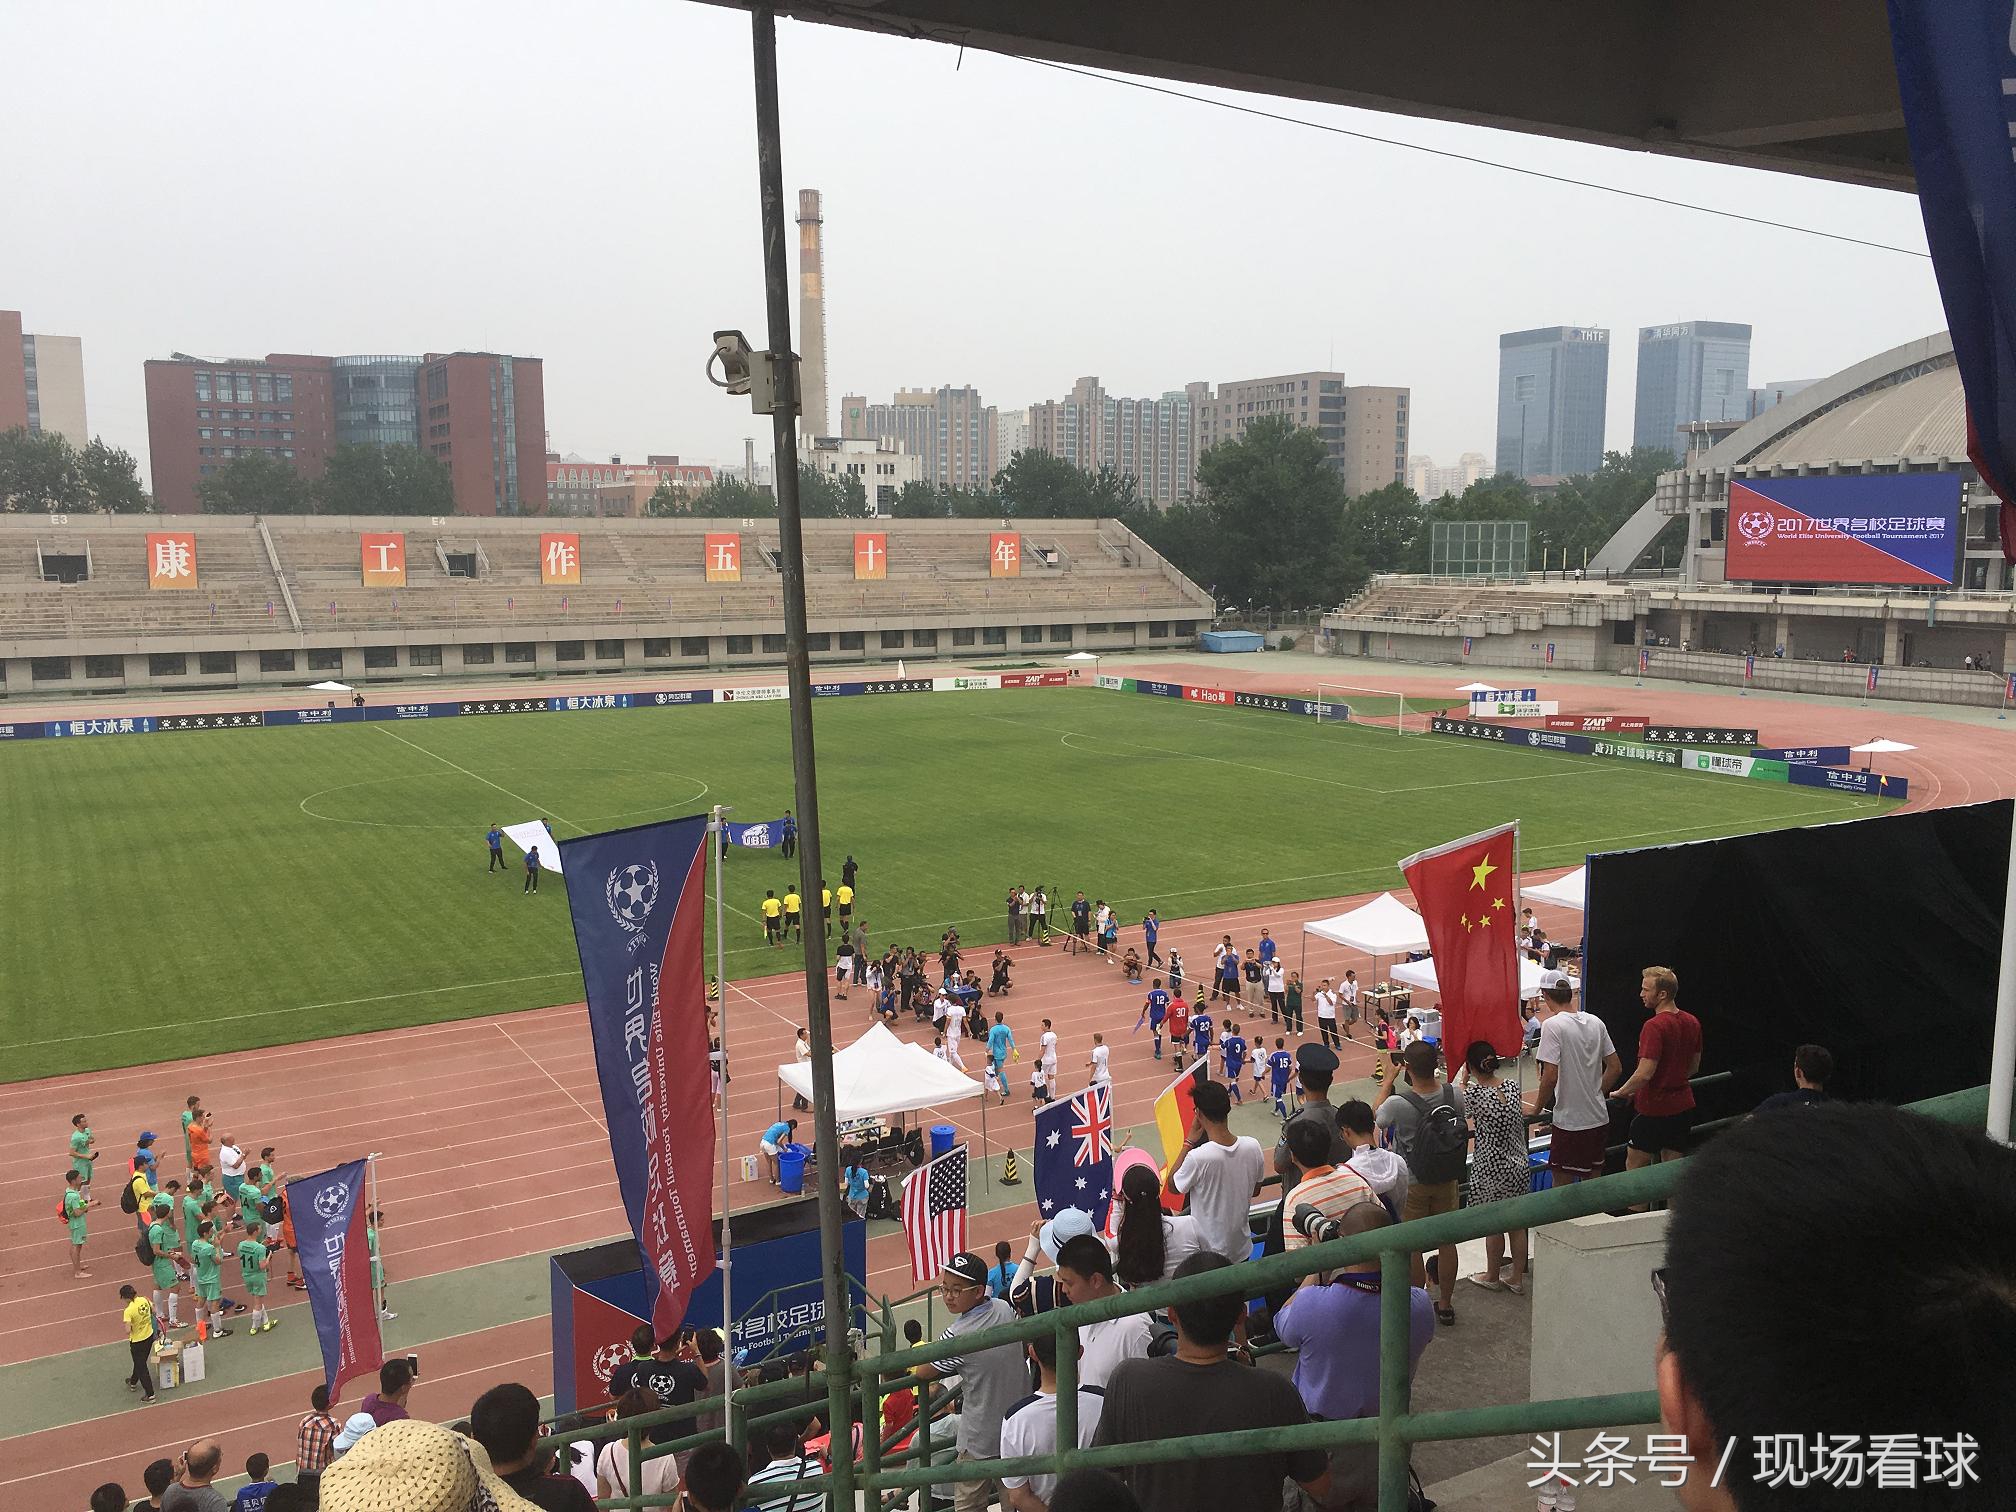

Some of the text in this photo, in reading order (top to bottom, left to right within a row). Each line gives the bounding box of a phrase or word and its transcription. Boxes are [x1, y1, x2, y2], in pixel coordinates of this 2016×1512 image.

[1580, 330, 1604, 342] THTF
[51, 514, 68, 525] E3
[742, 518, 754, 527] E5
[1776, 517, 1946, 532] 2017世界名校足球赛
[1815, 533, 1850, 541] University
[154, 539, 1017, 579] 康 工 作 五 十 年
[1485, 690, 1523, 702] 恒大冰泉
[567, 694, 616, 711] 恒大冰泉
[70, 718, 135, 736] 恒大冰泉
[1784, 749, 1818, 759] 信中利
[1711, 756, 1743, 770] 懂球帝
[1826, 770, 1867, 784] 信中利
[1156, 995, 1165, 1005] 12
[1175, 1007, 1186, 1018] 30
[1199, 1021, 1210, 1032] 23
[1235, 1043, 1241, 1053] 3
[1279, 1057, 1289, 1069] 15
[240, 1254, 254, 1269] 11
[748, 1334, 782, 1351] Footbal
